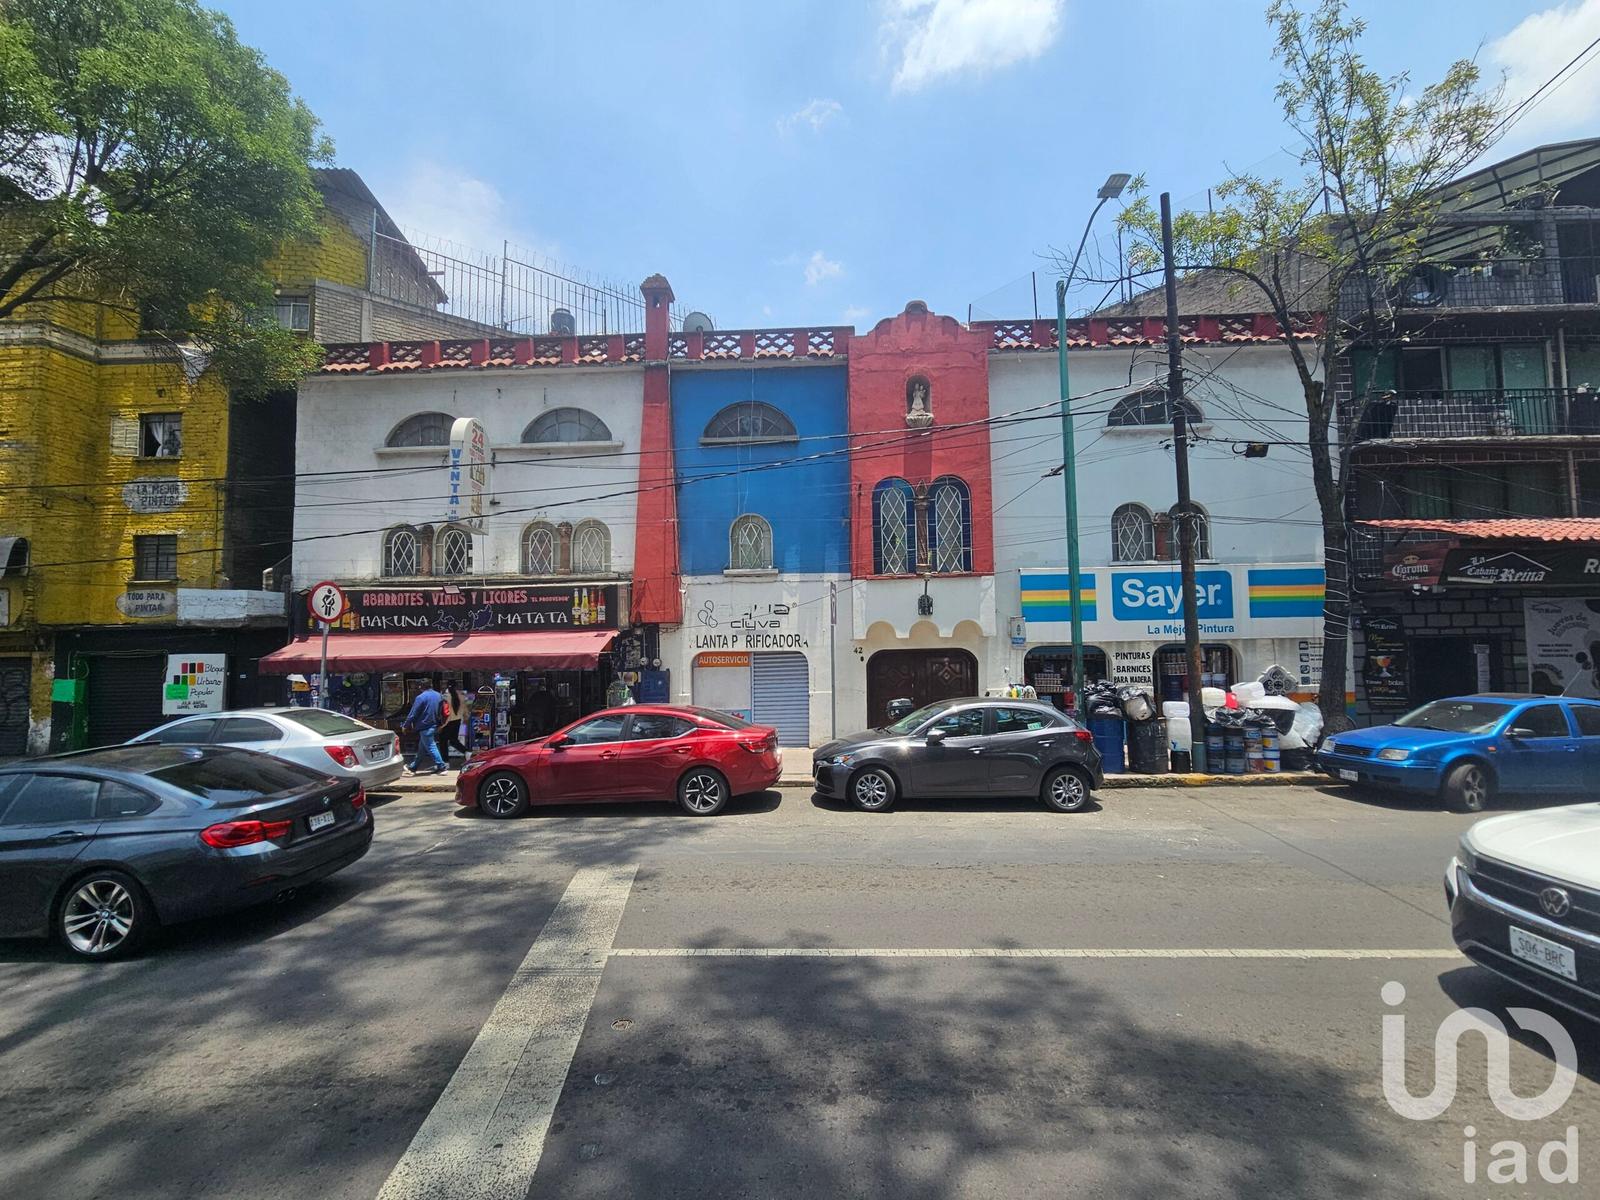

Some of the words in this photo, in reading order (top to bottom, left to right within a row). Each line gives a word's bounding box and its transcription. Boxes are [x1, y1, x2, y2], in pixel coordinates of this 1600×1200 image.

[471, 428, 484, 449] 24
[449, 448, 462, 505] VENTA
[136, 485, 148, 494] LA
[152, 484, 180, 495] MEJOR
[1391, 564, 1429, 577] Corona
[1583, 558, 1600, 574] R
[1498, 568, 1546, 582] Reina
[127, 593, 144, 601] TODO
[146, 592, 166, 601] PARA
[470, 592, 478, 605] Y
[482, 590, 528, 605] LICORES
[360, 615, 429, 629] HAKUNA
[497, 611, 568, 624] MATATA
[730, 618, 781, 631] clyva
[1147, 625, 1160, 635] La
[1163, 624, 1187, 636] Mejo
[1198, 624, 1235, 633] Pintura
[696, 634, 729, 649] LANTA
[853, 646, 863, 654] 42
[1114, 651, 1152, 660] PINTURAS
[698, 655, 749, 665] AUTOSERVICIO
[205, 663, 225, 675] Bloque
[1116, 665, 1152, 673] BARNICES
[196, 676, 222, 686] Urbano
[1113, 675, 1129, 684] PARA
[1129, 675, 1152, 684] MADERA
[190, 687, 215, 698] Popular
